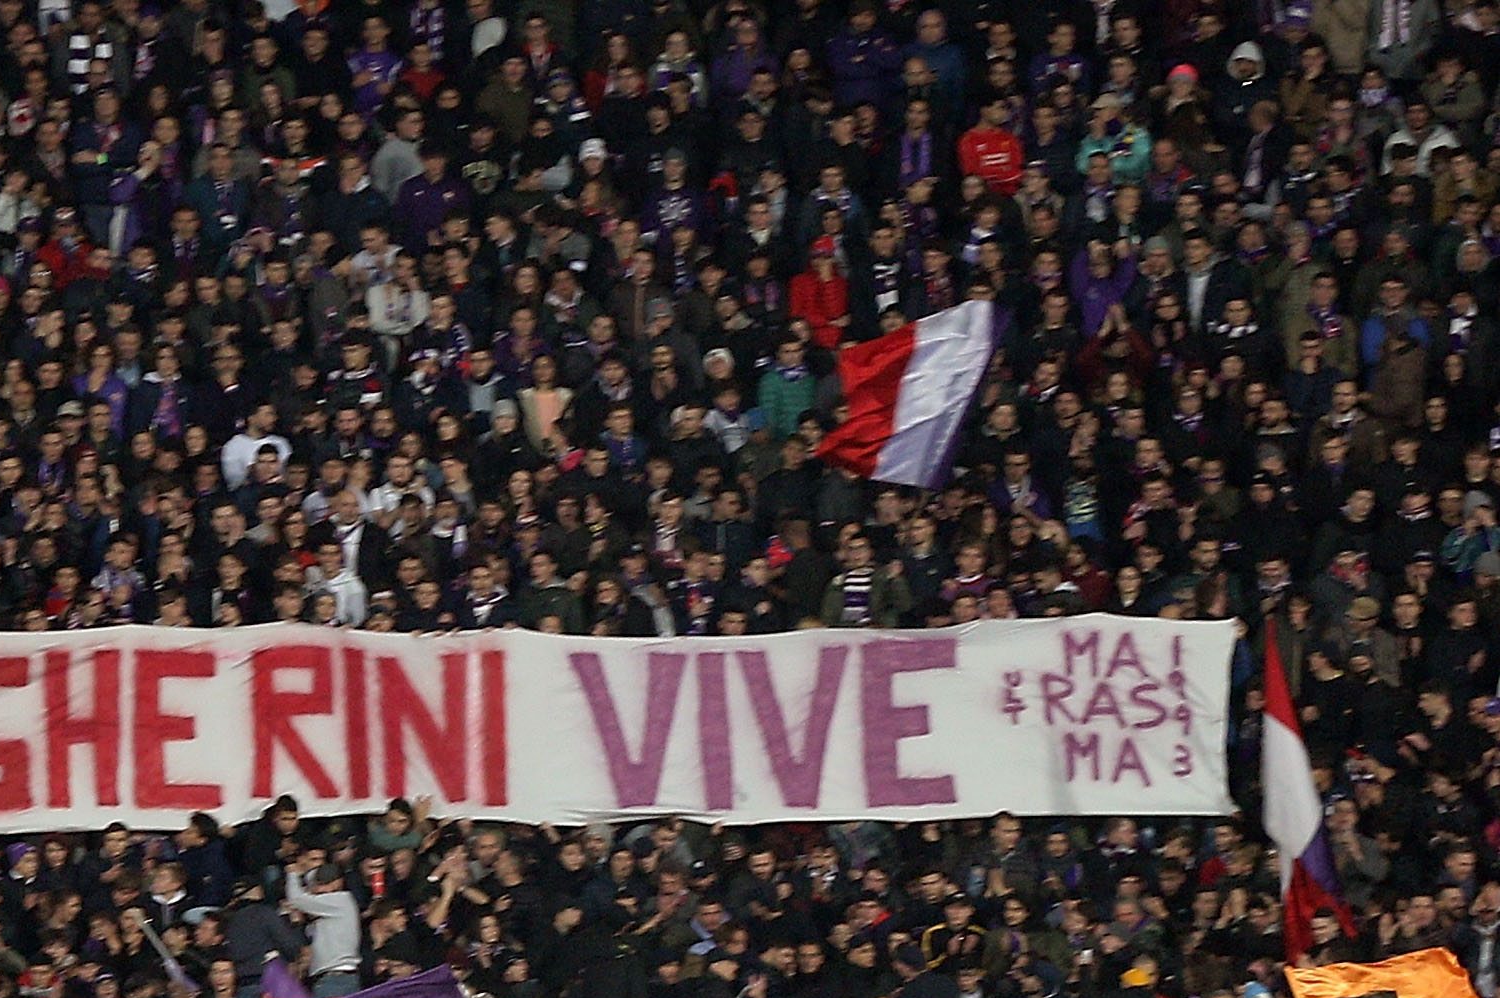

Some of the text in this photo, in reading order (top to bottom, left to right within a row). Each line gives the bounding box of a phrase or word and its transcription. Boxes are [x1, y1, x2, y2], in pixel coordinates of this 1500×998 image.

[1063, 630, 1150, 678] MA
[568, 636, 960, 812] VIVE
[1039, 671, 1169, 730] RAS
[1064, 732, 1152, 787] MA
